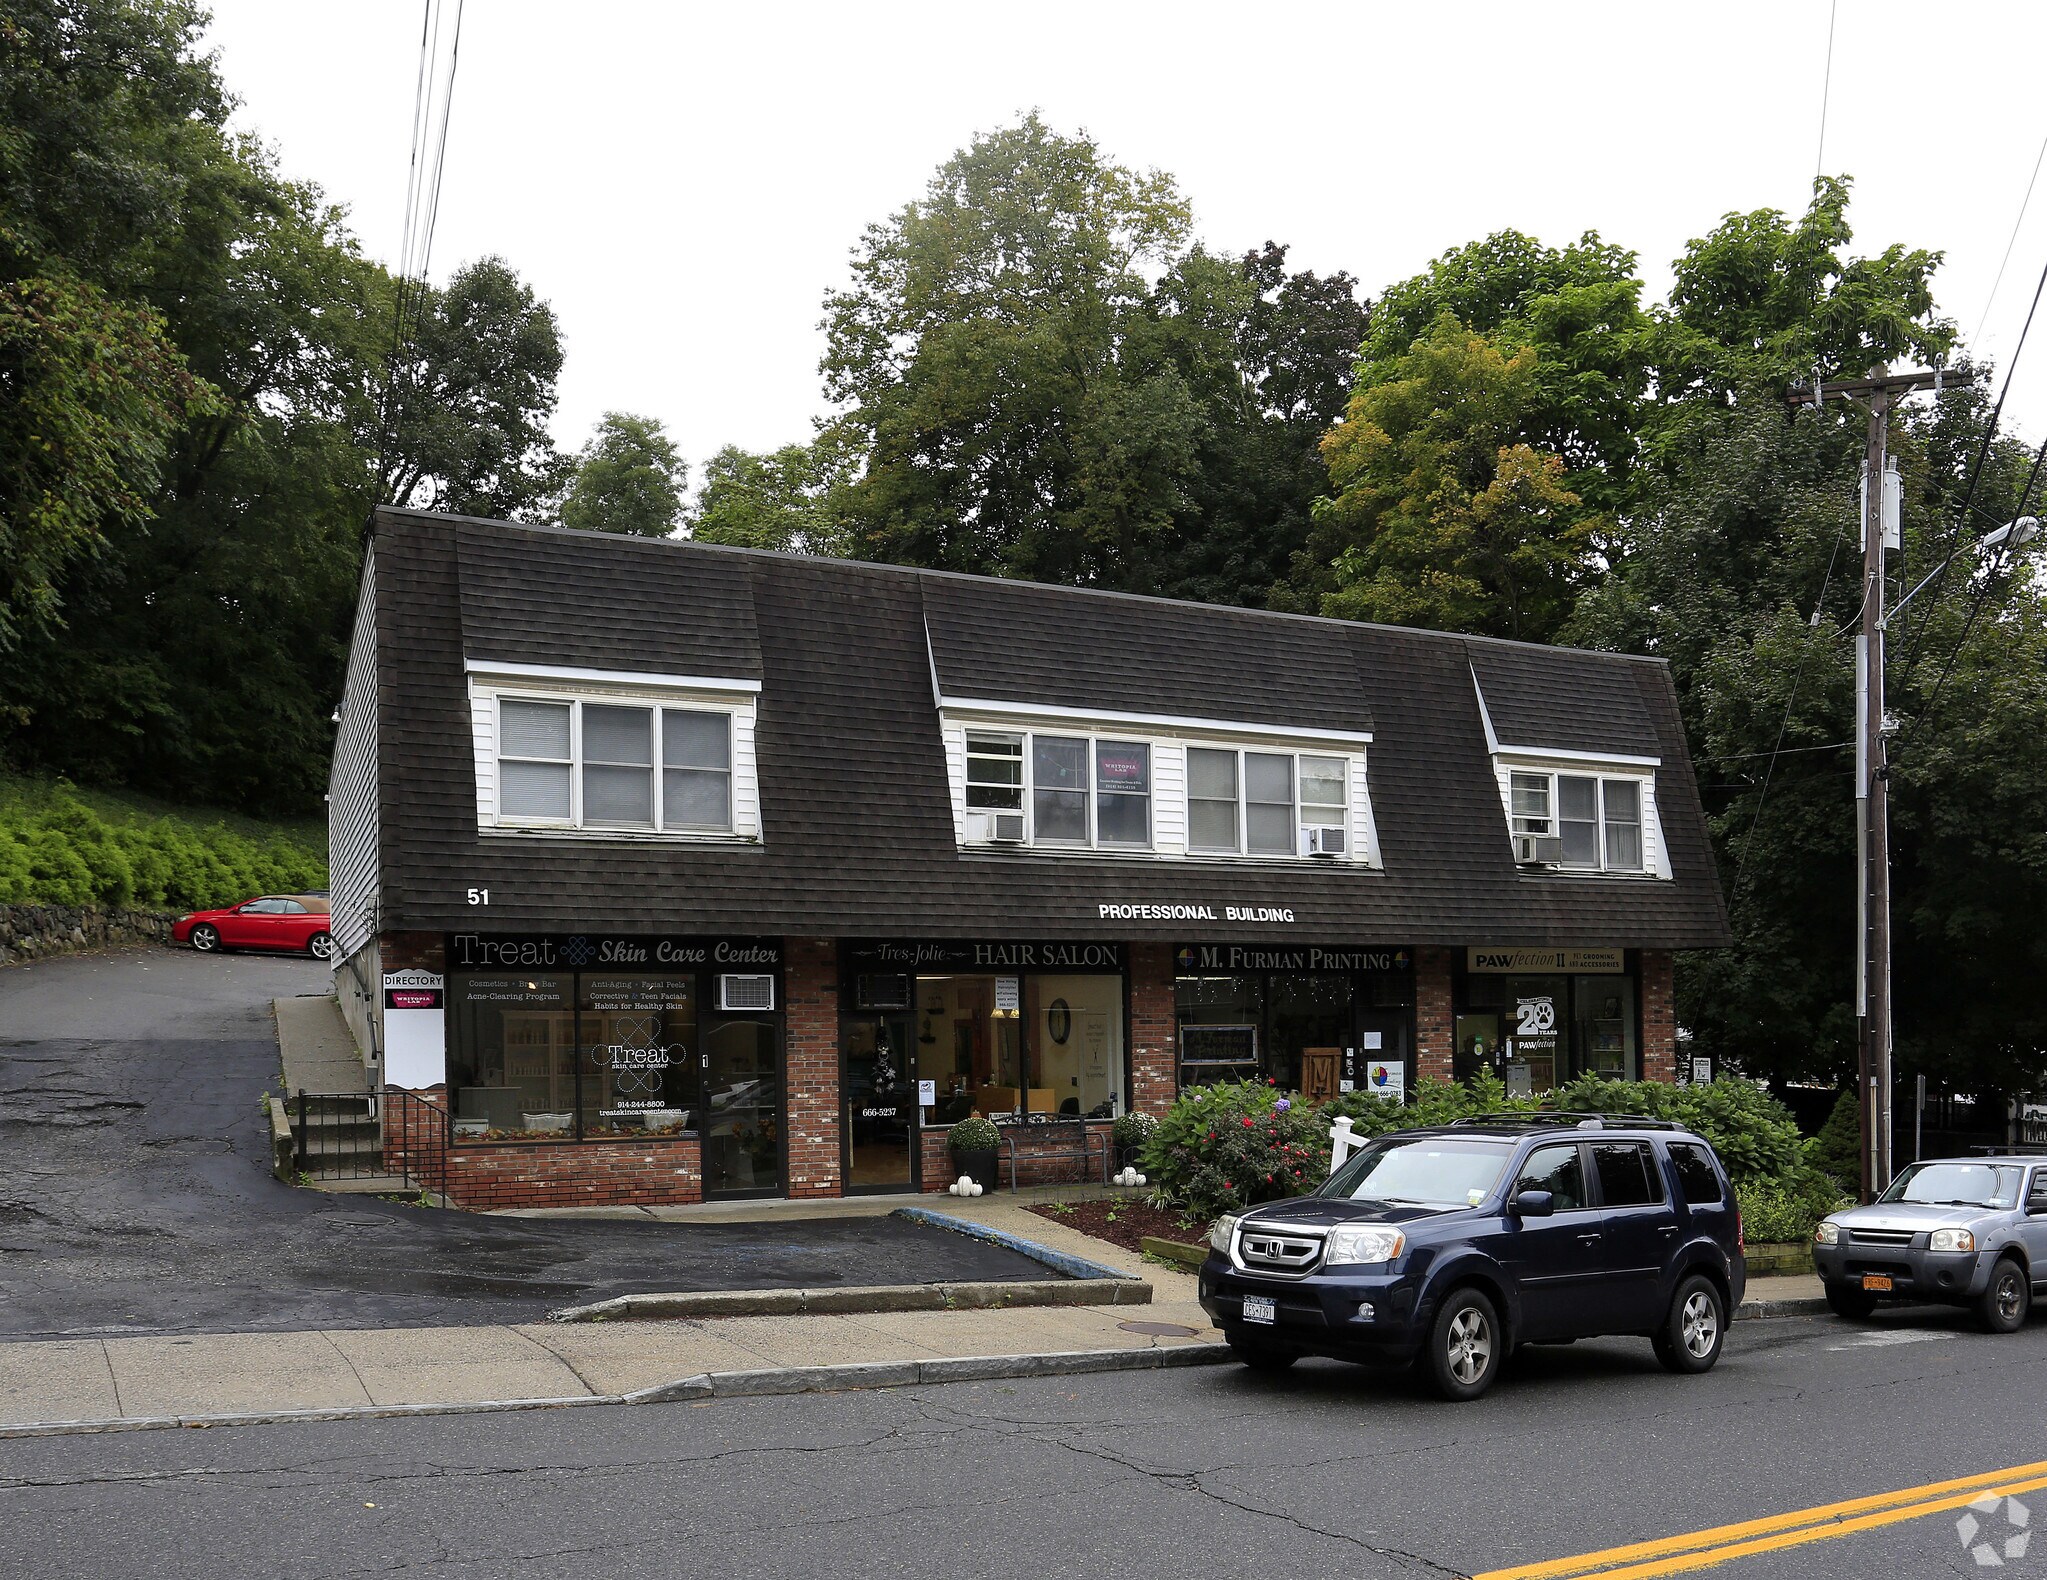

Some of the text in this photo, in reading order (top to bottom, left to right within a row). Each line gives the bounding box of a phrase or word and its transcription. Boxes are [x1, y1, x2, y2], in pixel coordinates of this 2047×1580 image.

[467, 888, 489, 905] 51
[1098, 904, 1295, 923] PROFESSIONAL BUILDING
[454, 935, 778, 965] Treat Skin Care Center
[877, 943, 1118, 967] Tres-Jolie HAIR SALON
[1200, 946, 1223, 968] M.
[1556, 953, 1565, 968] II
[385, 976, 442, 986] DIRECTORY
[519, 980, 540, 988] Brw
[591, 981, 632, 989] Anti-Aging
[467, 993, 560, 1001] Acne-Clearing Program
[1516, 1003, 1555, 1036] 20
[608, 1045, 669, 1063] Treat
[617, 1101, 665, 1109] 914-244-8800
[862, 1107, 897, 1117] 666-5237
